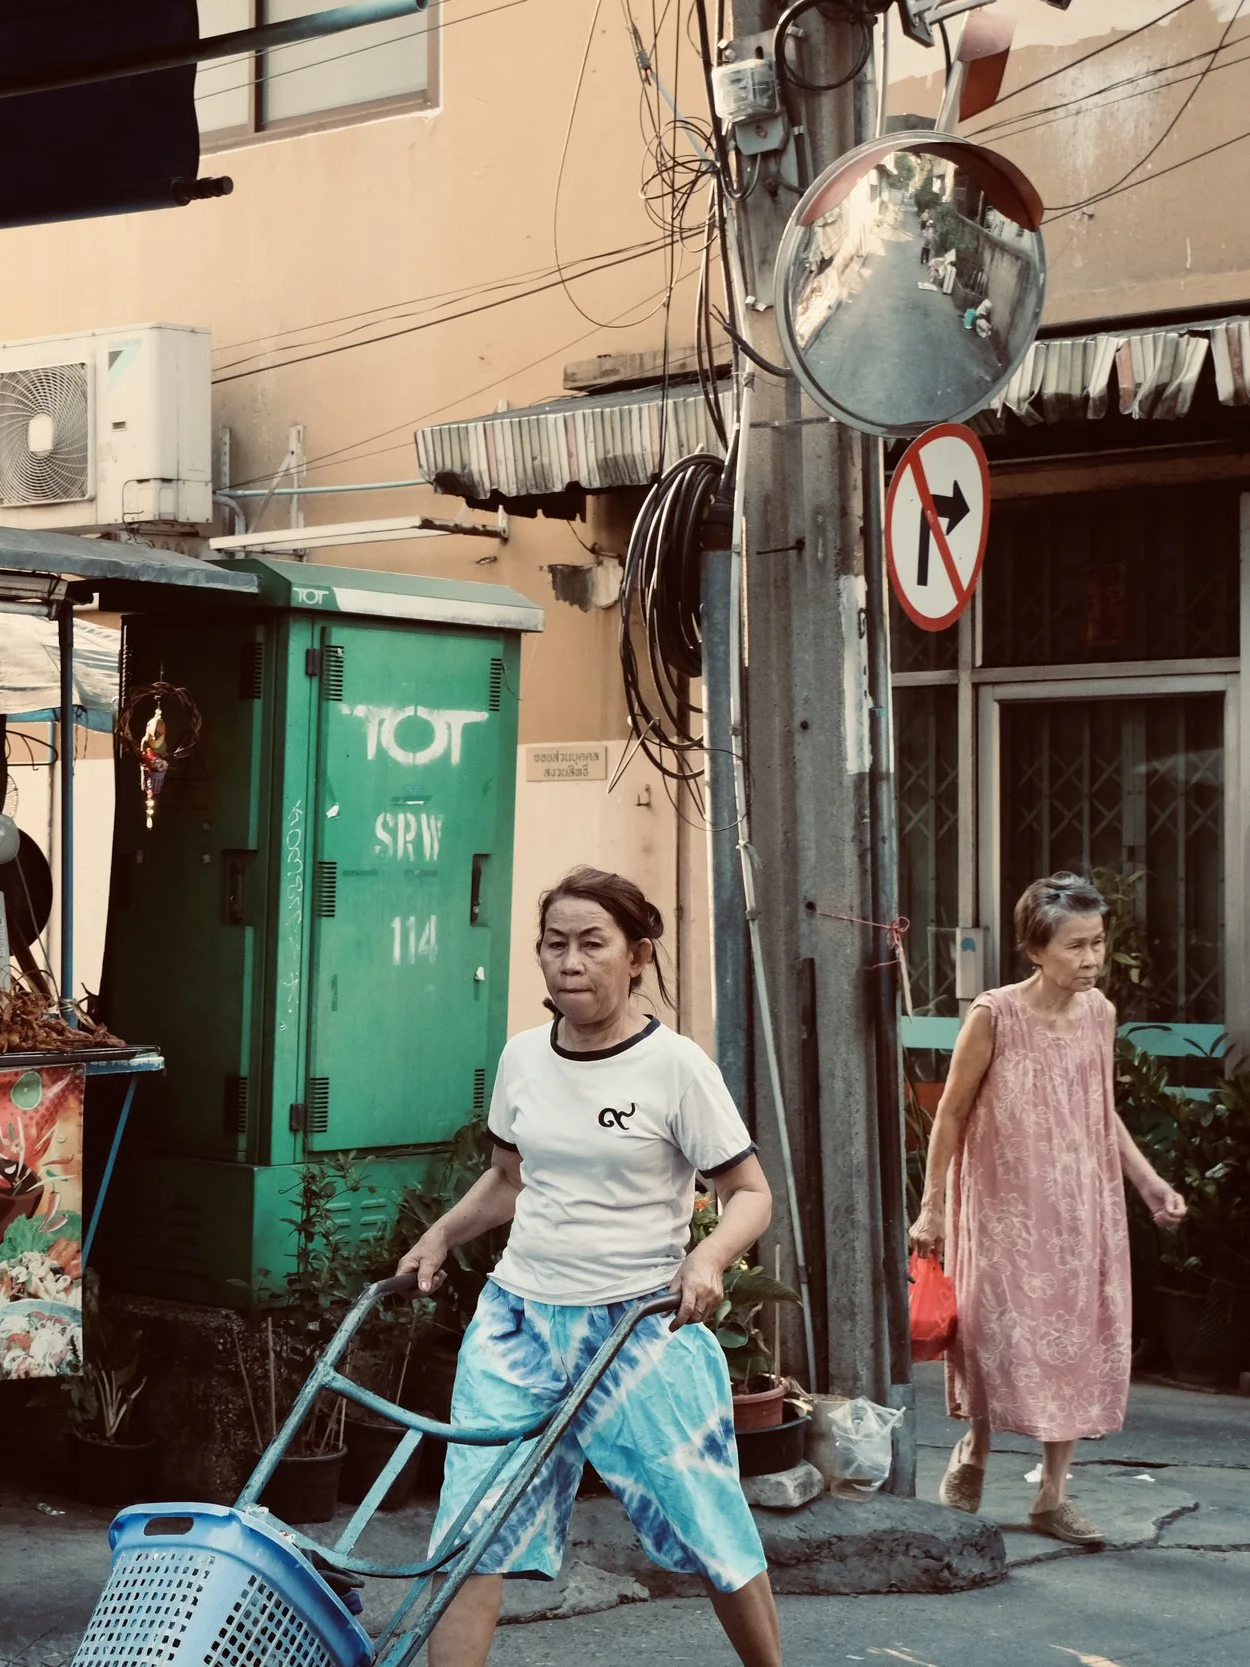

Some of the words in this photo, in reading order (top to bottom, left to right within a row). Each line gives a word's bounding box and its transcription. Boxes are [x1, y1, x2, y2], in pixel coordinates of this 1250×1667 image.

[292, 587, 330, 605] TOT
[340, 704, 489, 765] TOT
[533, 749, 599, 765] ซอยส่วนบุคคล
[374, 812, 443, 861] SRW
[391, 914, 438, 965] 114
